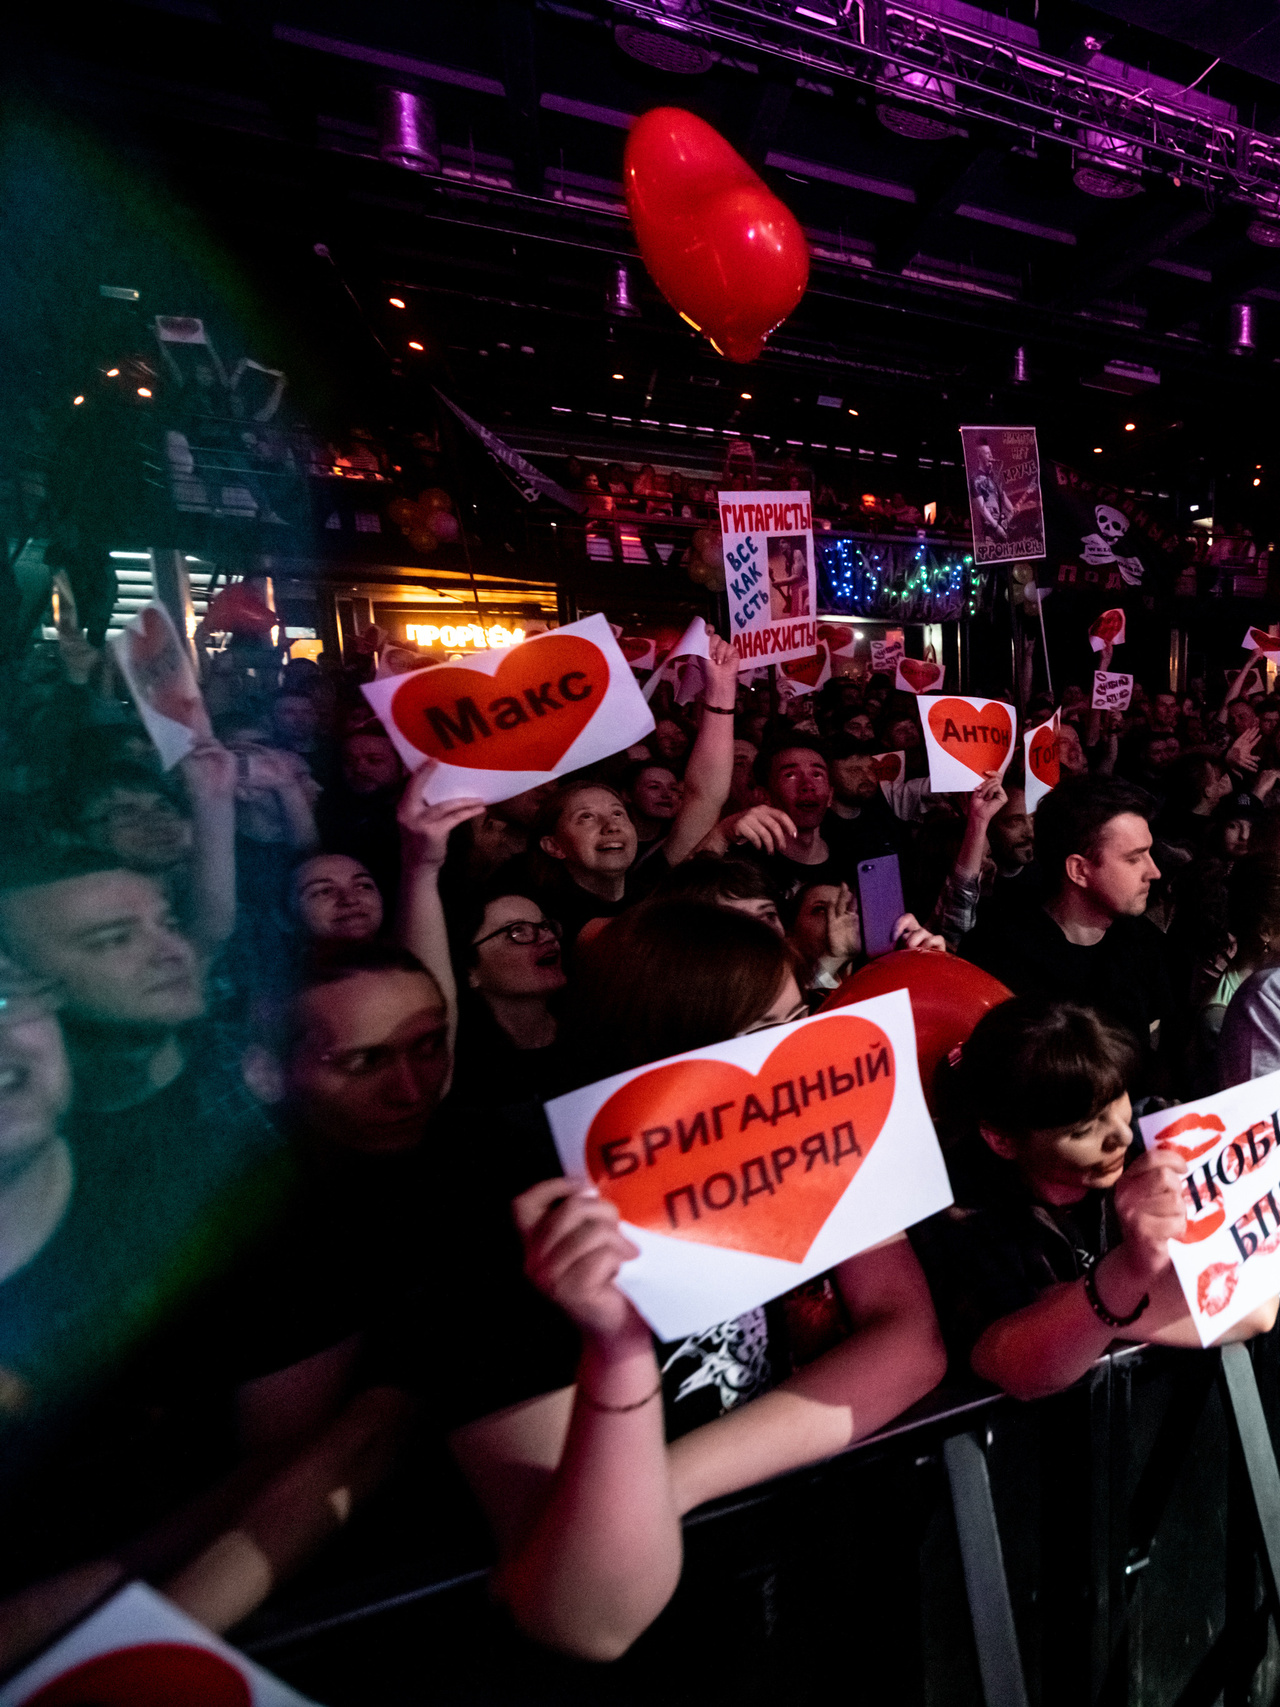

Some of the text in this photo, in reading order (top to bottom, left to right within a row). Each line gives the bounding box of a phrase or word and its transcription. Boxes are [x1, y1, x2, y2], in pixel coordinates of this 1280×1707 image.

[721, 503, 812, 533] ГИТАРИСТЫ
[726, 536, 758, 572] ВСЕ
[730, 562, 763, 600] КАК
[734, 589, 769, 628] ЕСТЬ
[733, 621, 816, 660] АНАРХИСТЫ
[423, 671, 593, 750] Макс
[942, 718, 1009, 747] Антон
[600, 1041, 891, 1181] БРИГАДНЫЙ
[663, 1120, 862, 1229] ПОДРЯД
